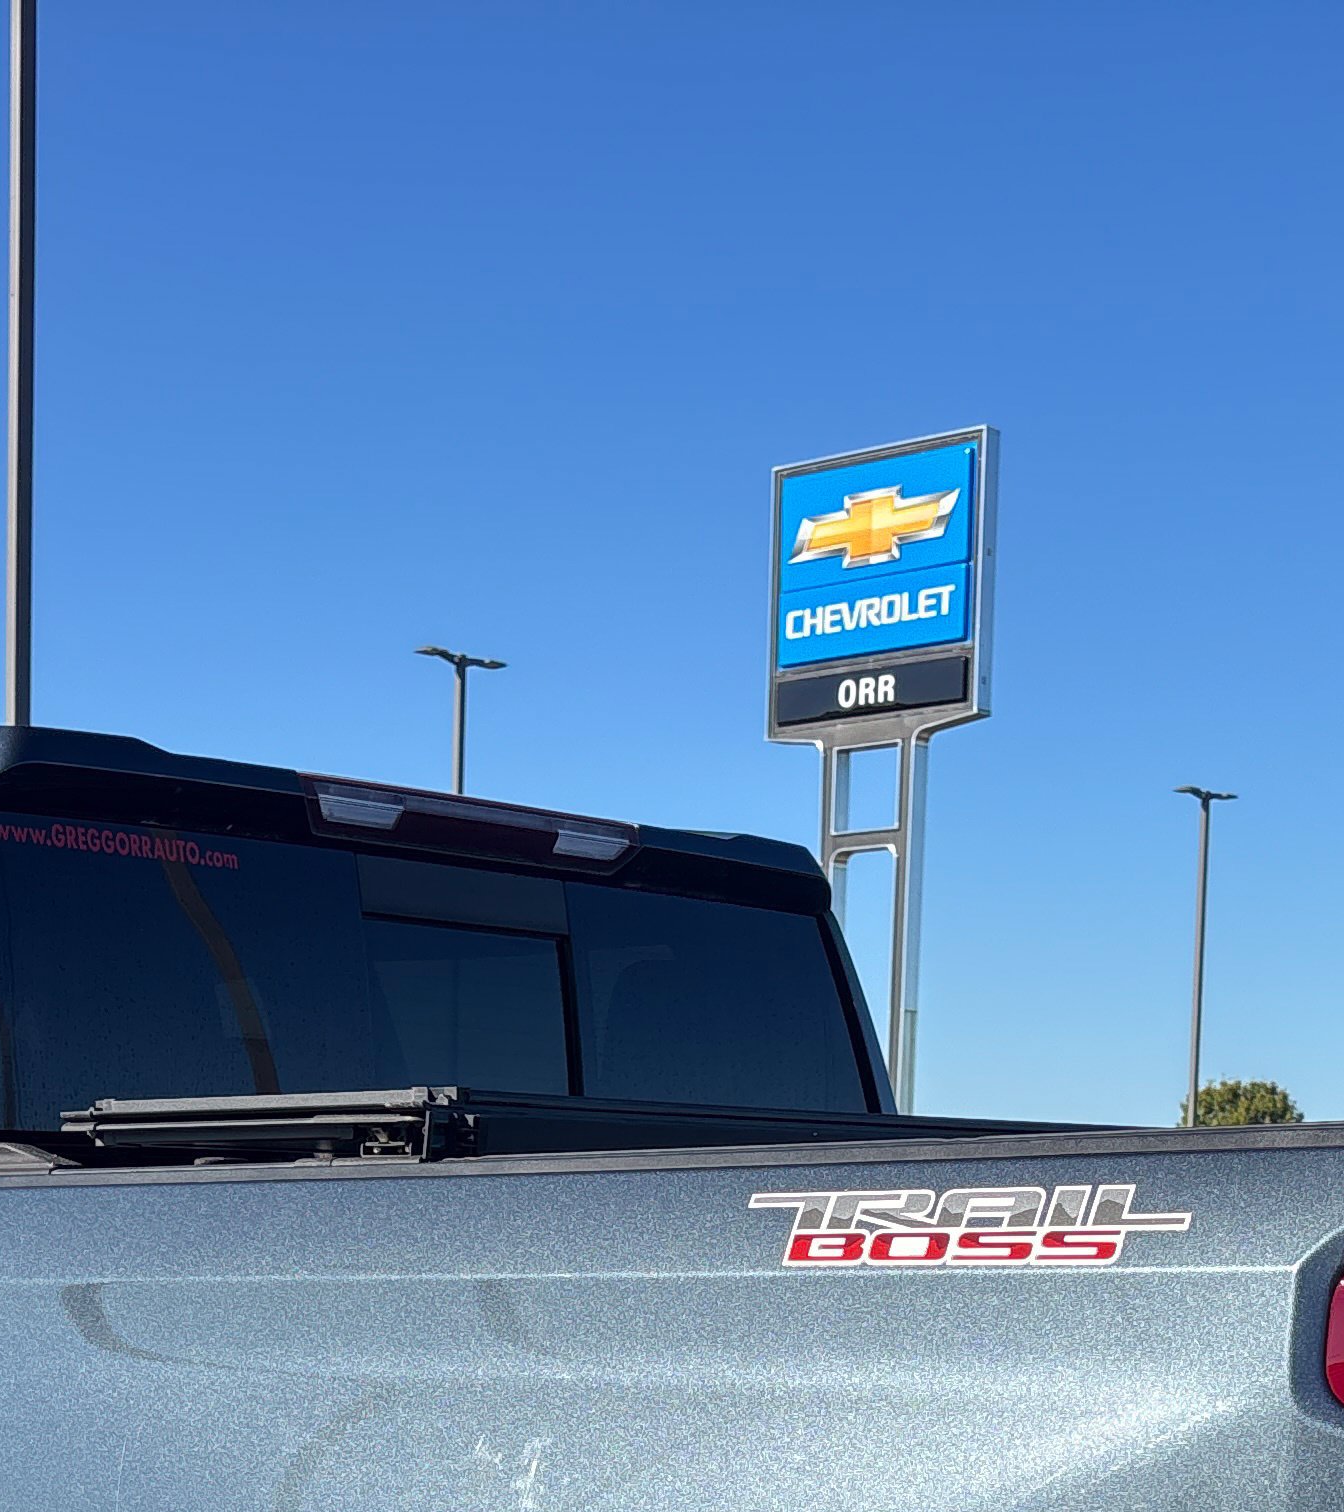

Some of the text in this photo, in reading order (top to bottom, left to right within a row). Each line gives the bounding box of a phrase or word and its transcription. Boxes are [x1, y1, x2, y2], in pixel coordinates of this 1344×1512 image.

[785, 584, 956, 640] CHEVROLET
[837, 674, 896, 708] ORR
[748, 1184, 1192, 1231] TRAIL
[782, 1229, 1126, 1267] BOSS
